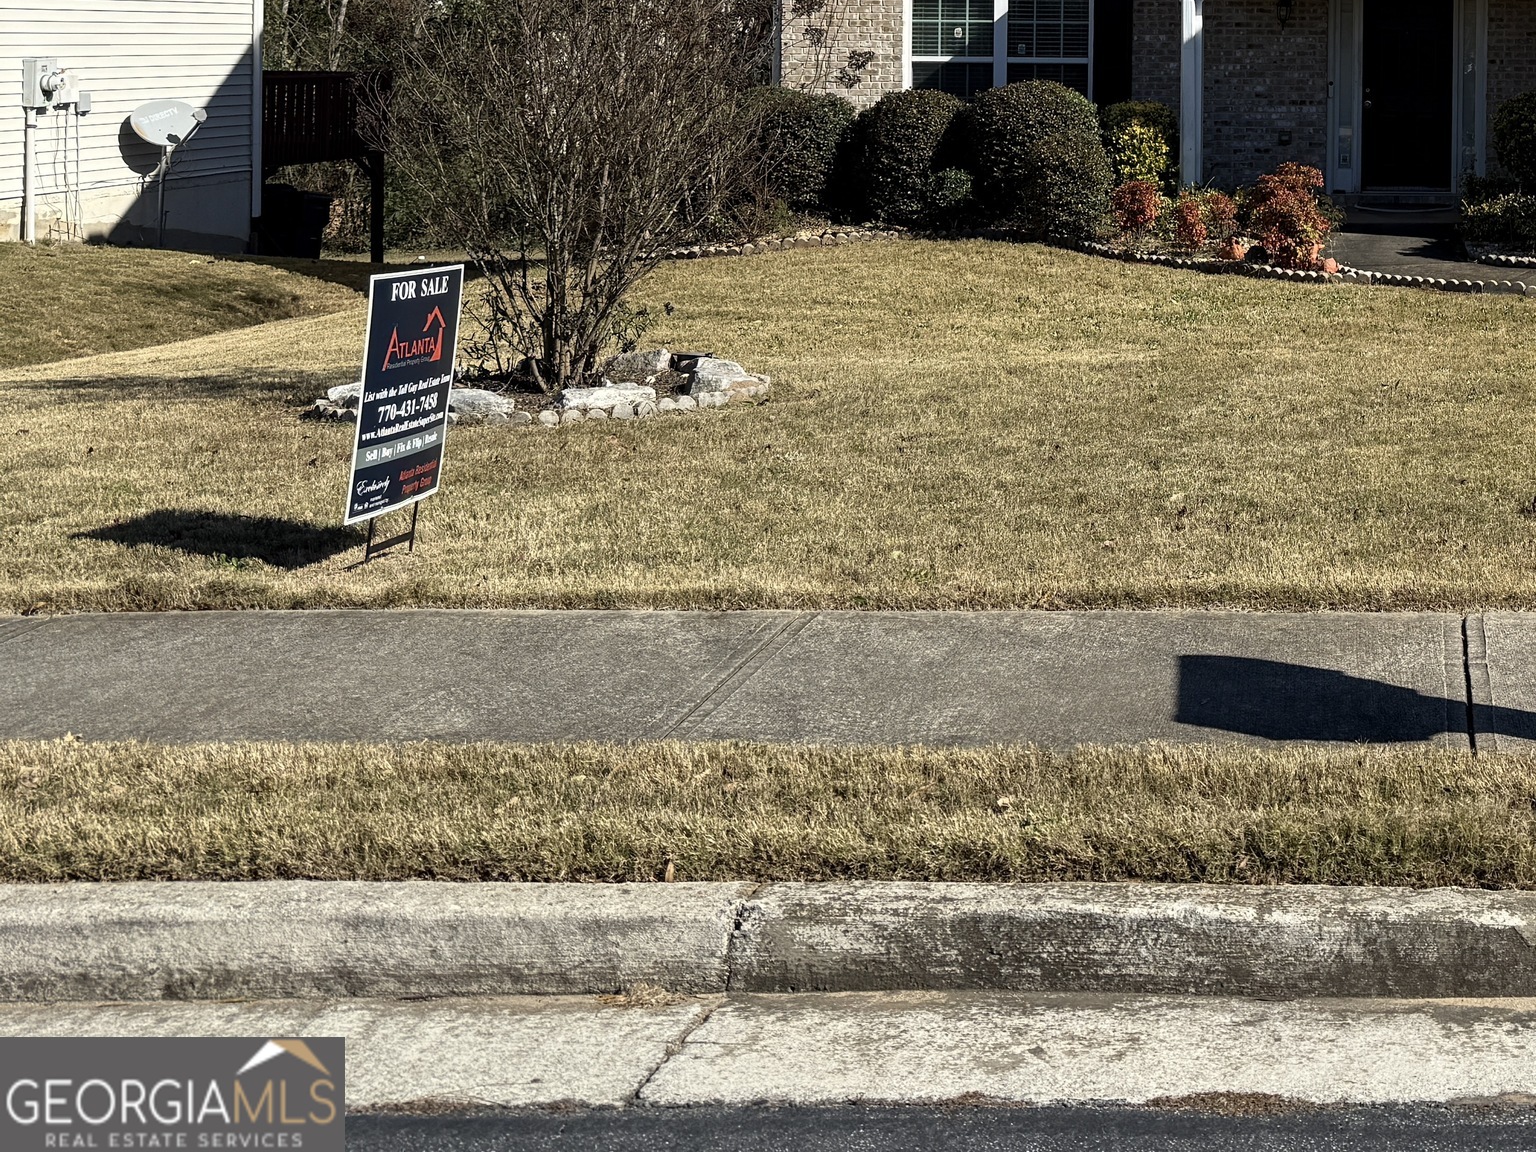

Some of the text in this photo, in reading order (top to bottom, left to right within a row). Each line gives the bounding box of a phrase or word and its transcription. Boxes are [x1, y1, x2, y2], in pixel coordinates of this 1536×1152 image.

[149, 107, 178, 122] DIRECTV
[391, 276, 449, 301] FOR SALE
[364, 392, 376, 403] List
[376, 388, 388, 400] with
[388, 386, 397, 397] the
[398, 383, 408, 395] Tall
[418, 378, 429, 390] Real
[365, 449, 378, 462] Sell
[397, 442, 406, 453] Fix
[407, 440, 411, 450] &
[412, 437, 422, 449] Flip
